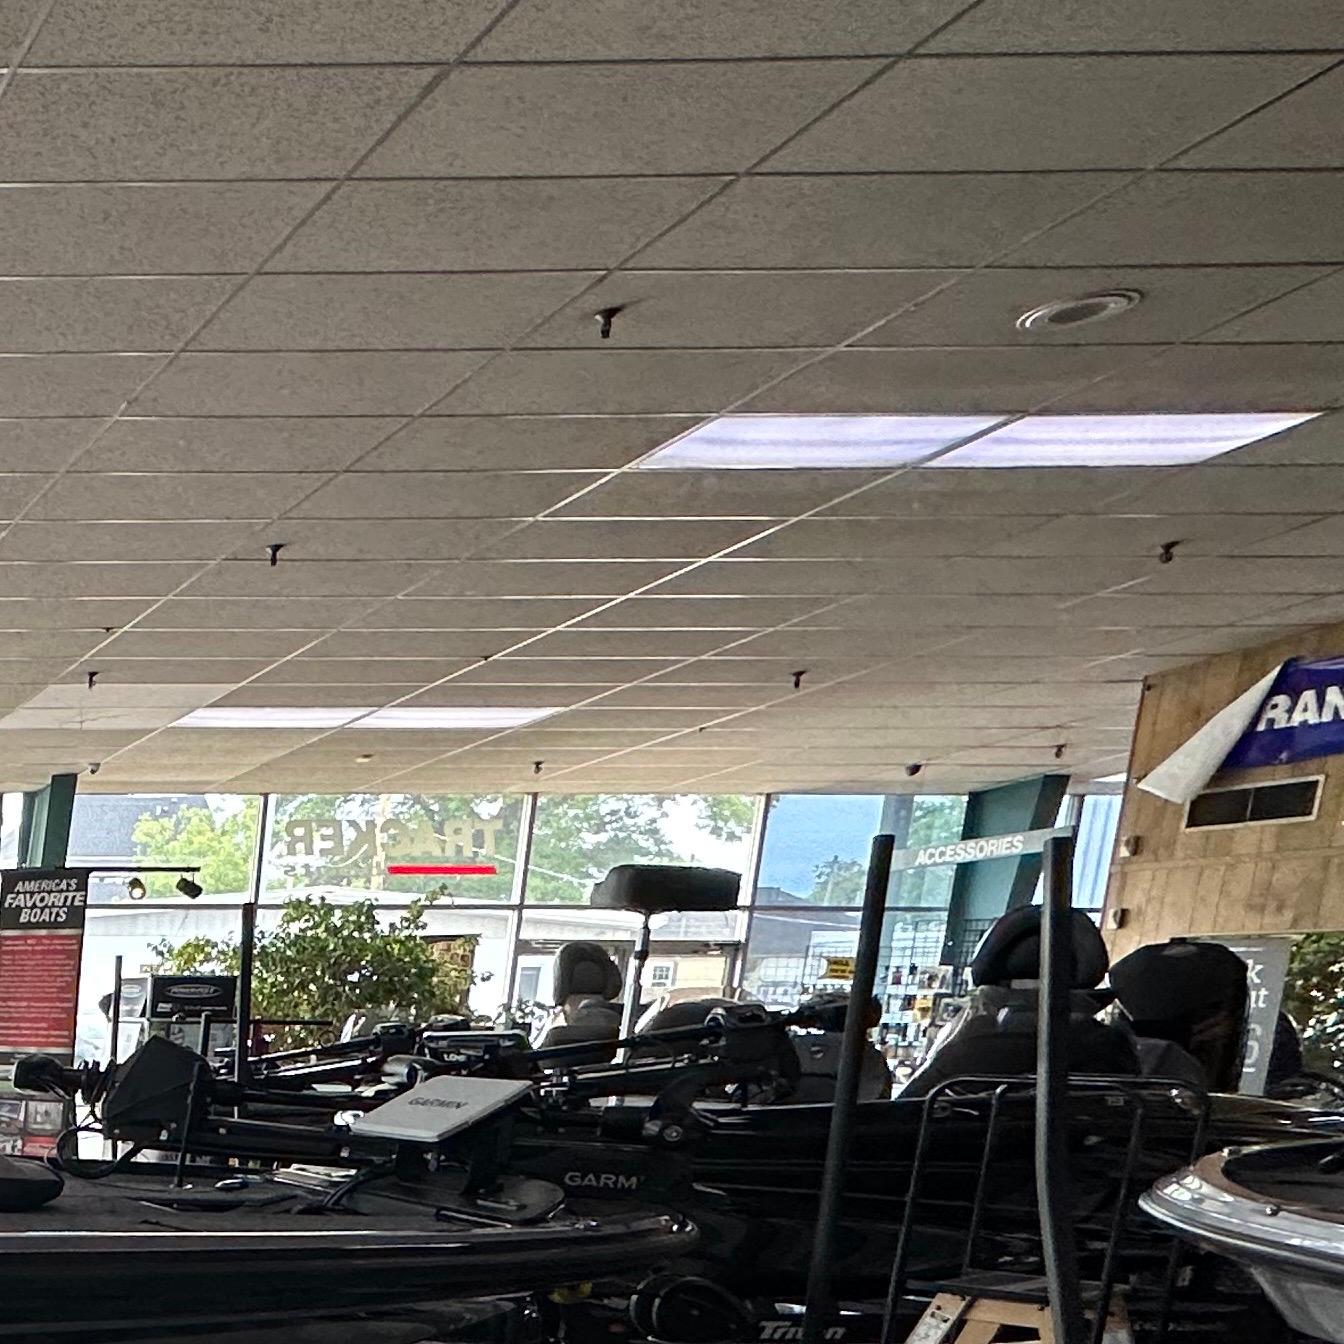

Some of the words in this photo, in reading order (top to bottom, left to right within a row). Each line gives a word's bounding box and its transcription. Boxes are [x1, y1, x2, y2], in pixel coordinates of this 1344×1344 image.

[914, 835, 1025, 867] ACCESSORIES
[14, 878, 78, 894] AMERICA'S
[3, 891, 87, 909] FAVORITE
[19, 907, 68, 923] BOATS
[564, 1171, 645, 1190] GARM
